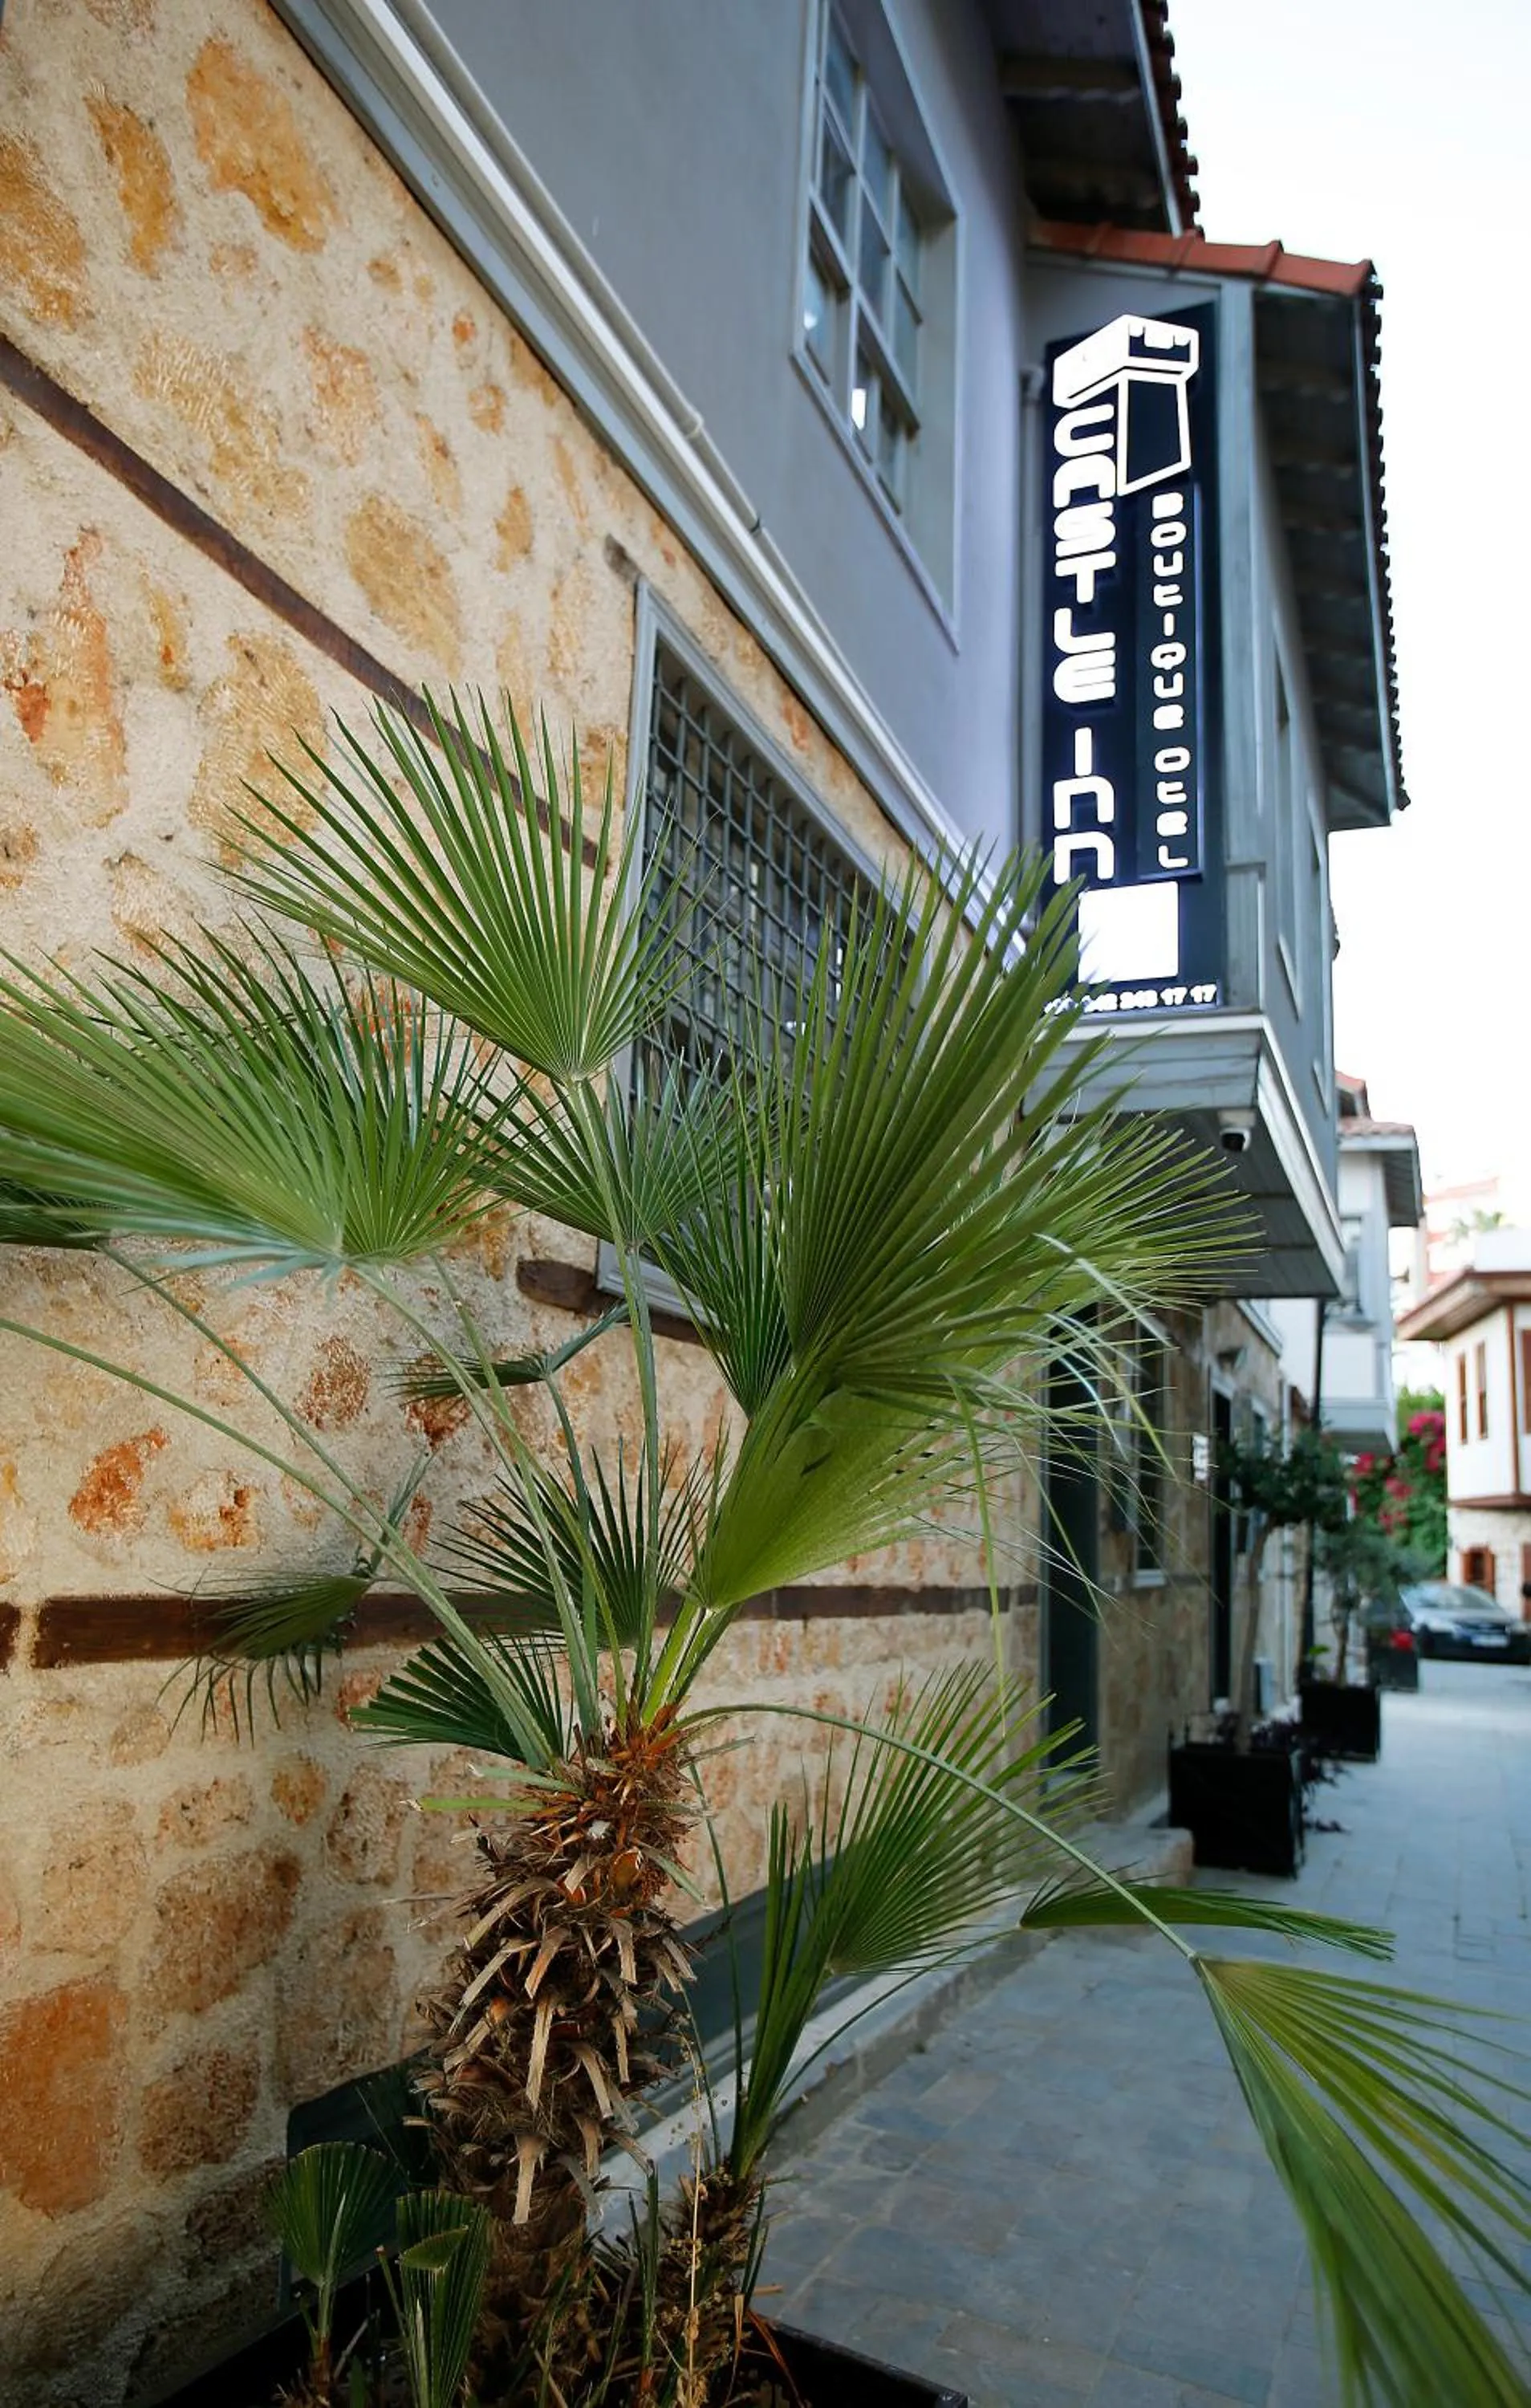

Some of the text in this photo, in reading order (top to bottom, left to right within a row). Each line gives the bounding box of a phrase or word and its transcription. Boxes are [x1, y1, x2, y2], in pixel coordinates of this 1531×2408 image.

[1053, 403, 1116, 702] CASTLE
[1150, 491, 1188, 730] BOUTIQUE
[1159, 986, 1188, 1006] 17
[1190, 984, 1217, 1003] 17
